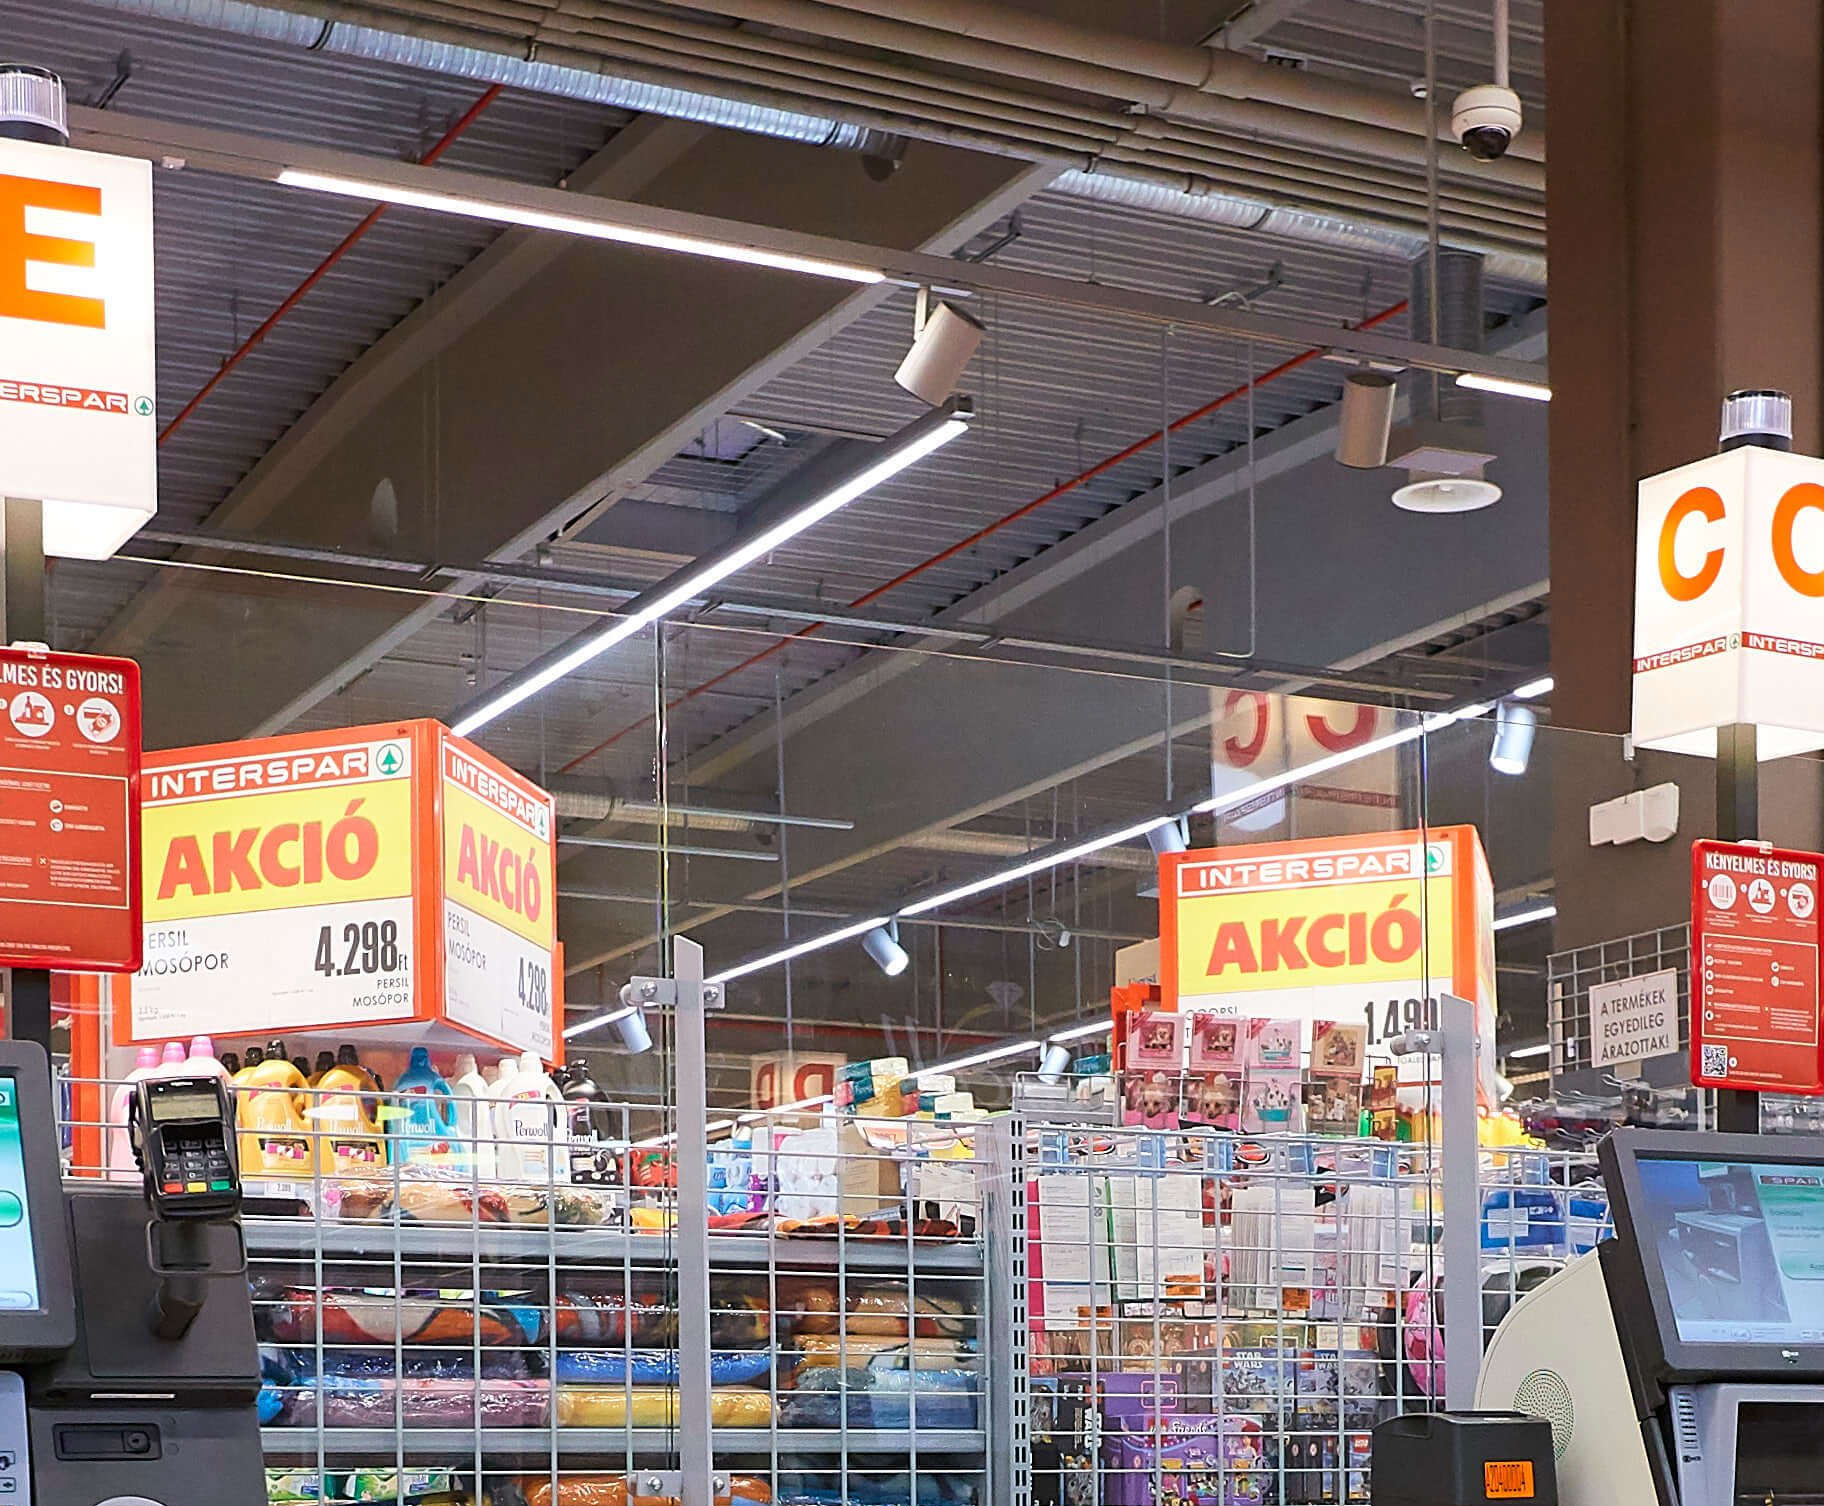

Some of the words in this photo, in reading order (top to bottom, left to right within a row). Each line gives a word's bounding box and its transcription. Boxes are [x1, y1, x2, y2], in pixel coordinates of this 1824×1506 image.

[1658, 486, 1726, 602] C
[1637, 638, 1727, 671] INTERSPAR
[42, 663, 62, 689] ÉS
[65, 670, 124, 695] GYORS!
[151, 753, 367, 798] INTERSPAR
[451, 756, 536, 822] INTERSPAR
[157, 799, 379, 900] AKCIÓ
[1706, 851, 1766, 875] KÉNYELMES
[1768, 858, 1780, 876] ÉS
[1781, 861, 1817, 881] GYORS!
[457, 824, 542, 923] AKCIÓ
[1199, 850, 1410, 888] INTERSPAR
[314, 919, 398, 978] 4.298
[397, 954, 409, 972] Ft
[1206, 893, 1421, 976] AKCIÓ
[352, 990, 409, 1008] MOSÓPOR
[376, 977, 409, 990] PERSIL
[518, 956, 547, 1017] 4.298
[1601, 1001, 1609, 1017] A
[1611, 989, 1666, 1012] TERMÉKEK
[1604, 1013, 1665, 1038] EGYEDILEG
[1601, 1037, 1670, 1062] ÁRAZOTTAK!
